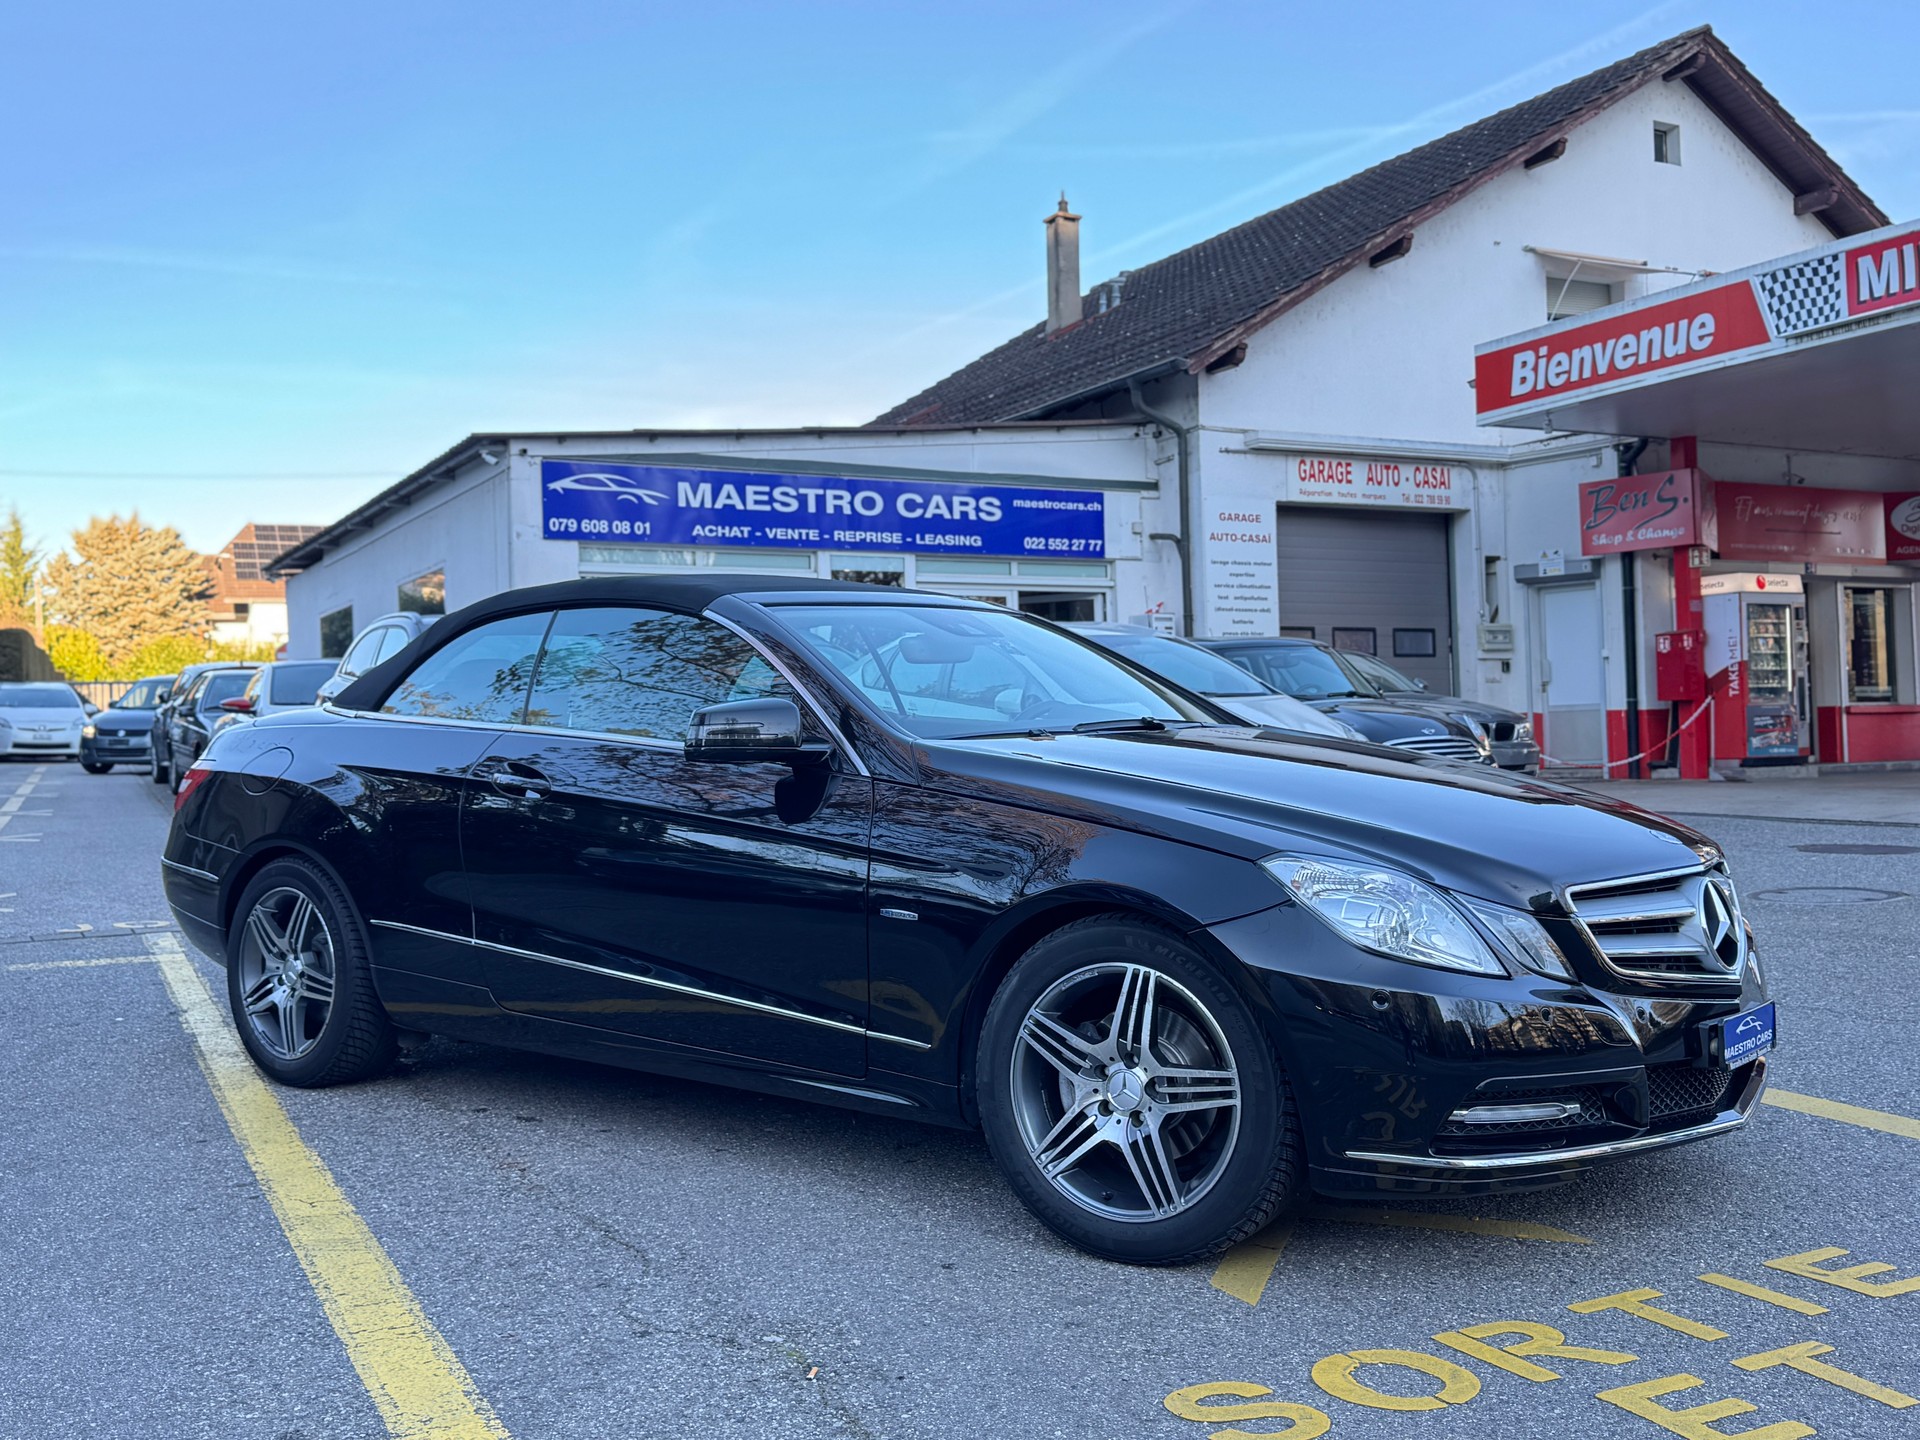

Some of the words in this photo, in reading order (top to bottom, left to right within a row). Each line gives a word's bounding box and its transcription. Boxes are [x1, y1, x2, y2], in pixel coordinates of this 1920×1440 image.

[1509, 312, 1716, 398] Bienvenue
[1298, 458, 1353, 485] GARAGE
[1366, 463, 1401, 488] AUTO
[677, 481, 885, 517] MAESTRO
[896, 492, 1003, 523] CARS
[1013, 499, 1102, 512] maestrocars.ch
[1337, 490, 1357, 499] toutes
[1362, 493, 1387, 501] marques
[1584, 484, 1650, 532] Ben
[549, 517, 578, 533] 079
[581, 519, 609, 534] 608
[612, 520, 631, 535] 08
[634, 521, 651, 536] 01
[1219, 512, 1262, 524] GARAGE
[691, 524, 752, 539] ACHAT
[765, 527, 820, 542] VENTE
[834, 530, 903, 545] REPRISE
[915, 533, 983, 548] LEASING
[1023, 537, 1046, 550] 022
[1047, 538, 1070, 551] 552
[1071, 539, 1086, 552] 27
[1088, 540, 1103, 552] 77
[1591, 534, 1624, 546] Shop
[1625, 531, 1635, 543] &
[1637, 527, 1685, 541] Change
[1767, 579, 1789, 588] selecta
[1727, 661, 1740, 698] TAKE
[1154, 944, 1231, 1004] MICHELIN
[1724, 1037, 1756, 1060] MAESTRO
[1756, 1029, 1773, 1046] CARS
[1163, 1246, 1920, 1440] SORTIE
